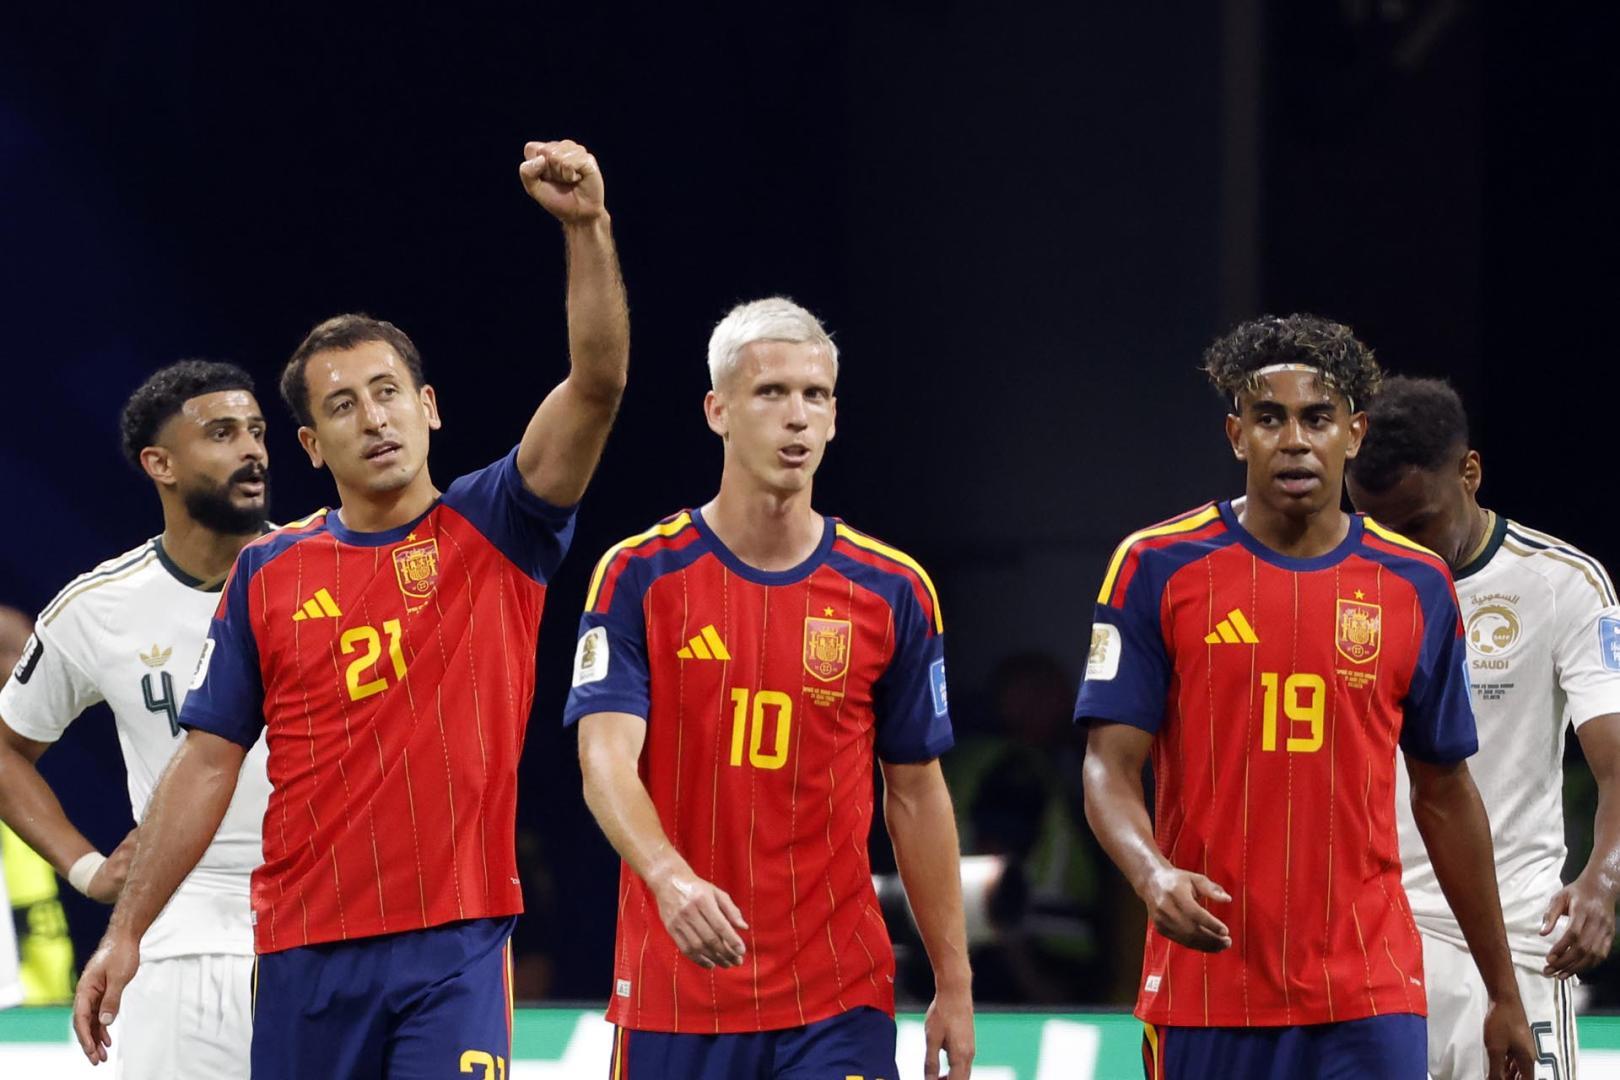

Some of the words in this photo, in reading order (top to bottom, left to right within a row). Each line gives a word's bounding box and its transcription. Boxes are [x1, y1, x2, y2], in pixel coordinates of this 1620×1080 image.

[341, 619, 408, 701] 21
[1472, 659, 1509, 670] SAUDI
[141, 671, 182, 738] 4
[730, 687, 792, 769] 10
[1261, 672, 1325, 752] 19
